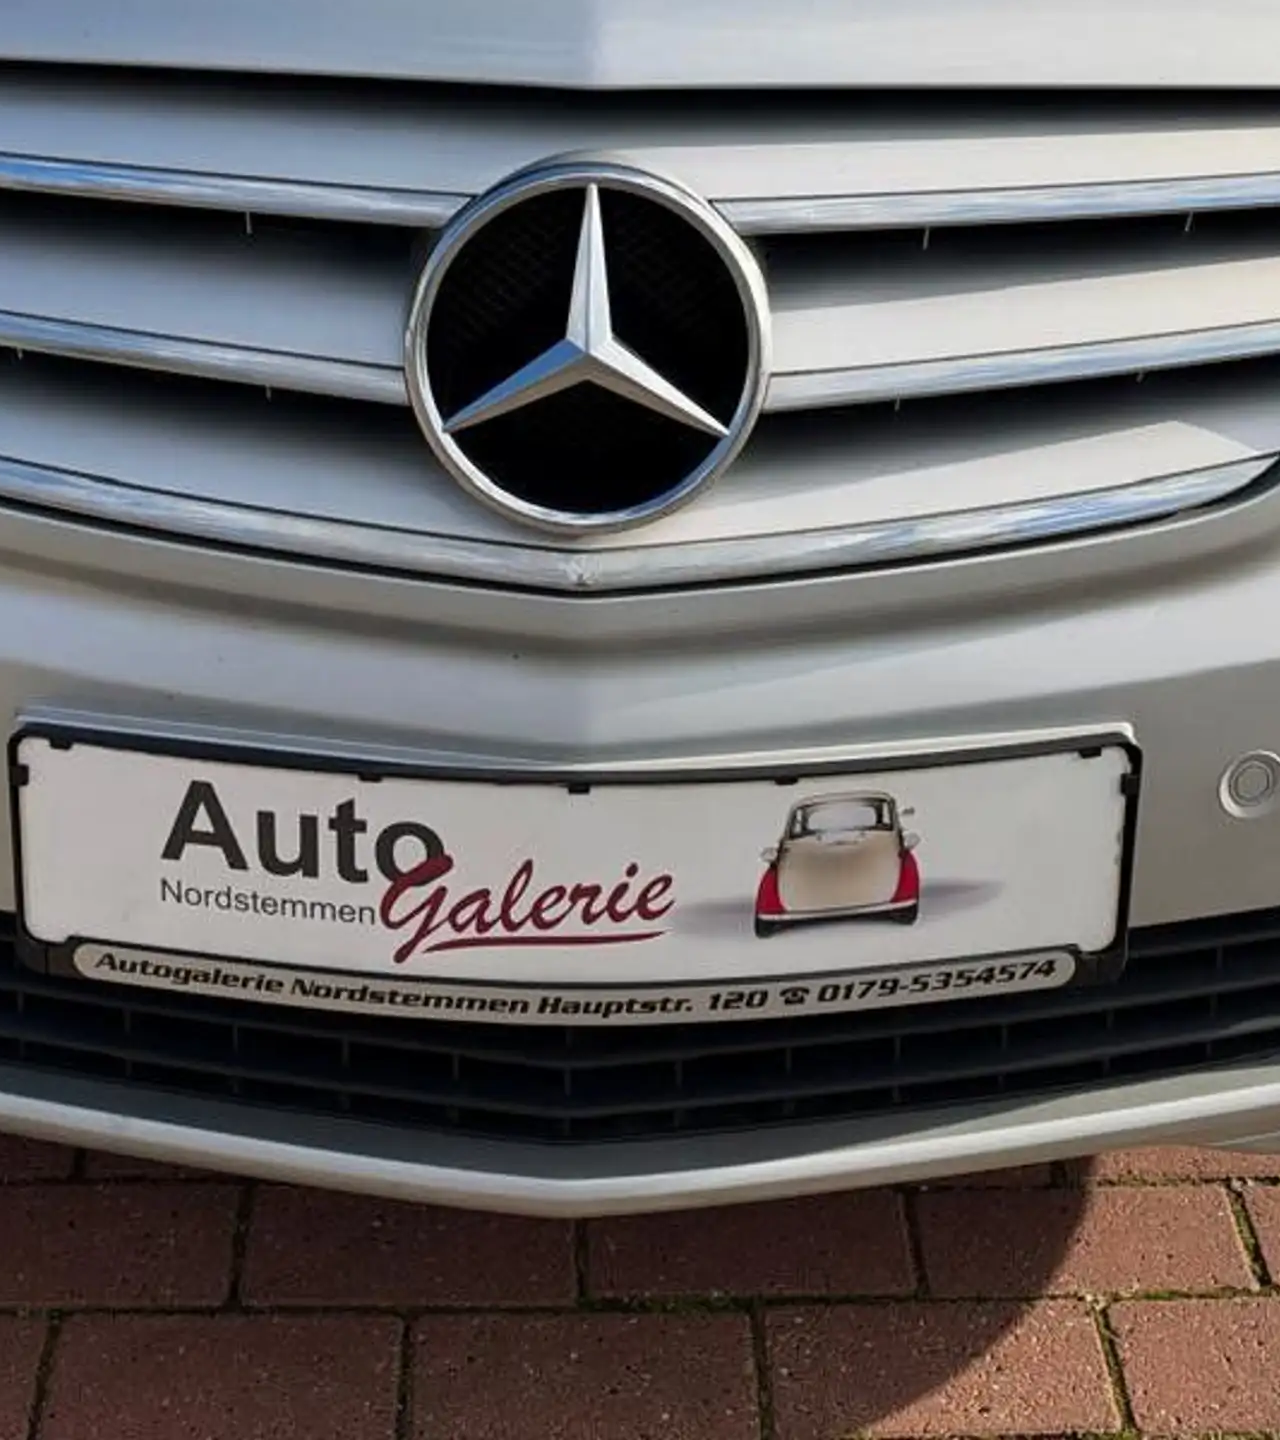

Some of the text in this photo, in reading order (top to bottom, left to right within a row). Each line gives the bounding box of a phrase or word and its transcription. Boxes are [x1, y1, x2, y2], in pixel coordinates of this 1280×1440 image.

[160, 779, 446, 887] Auto
[159, 876, 377, 926] Nordstemmen
[379, 853, 676, 964] Galerie
[94, 952, 1059, 1018] Autogalerie Nordstemmen Hauptstr. 120 0179-5354574
